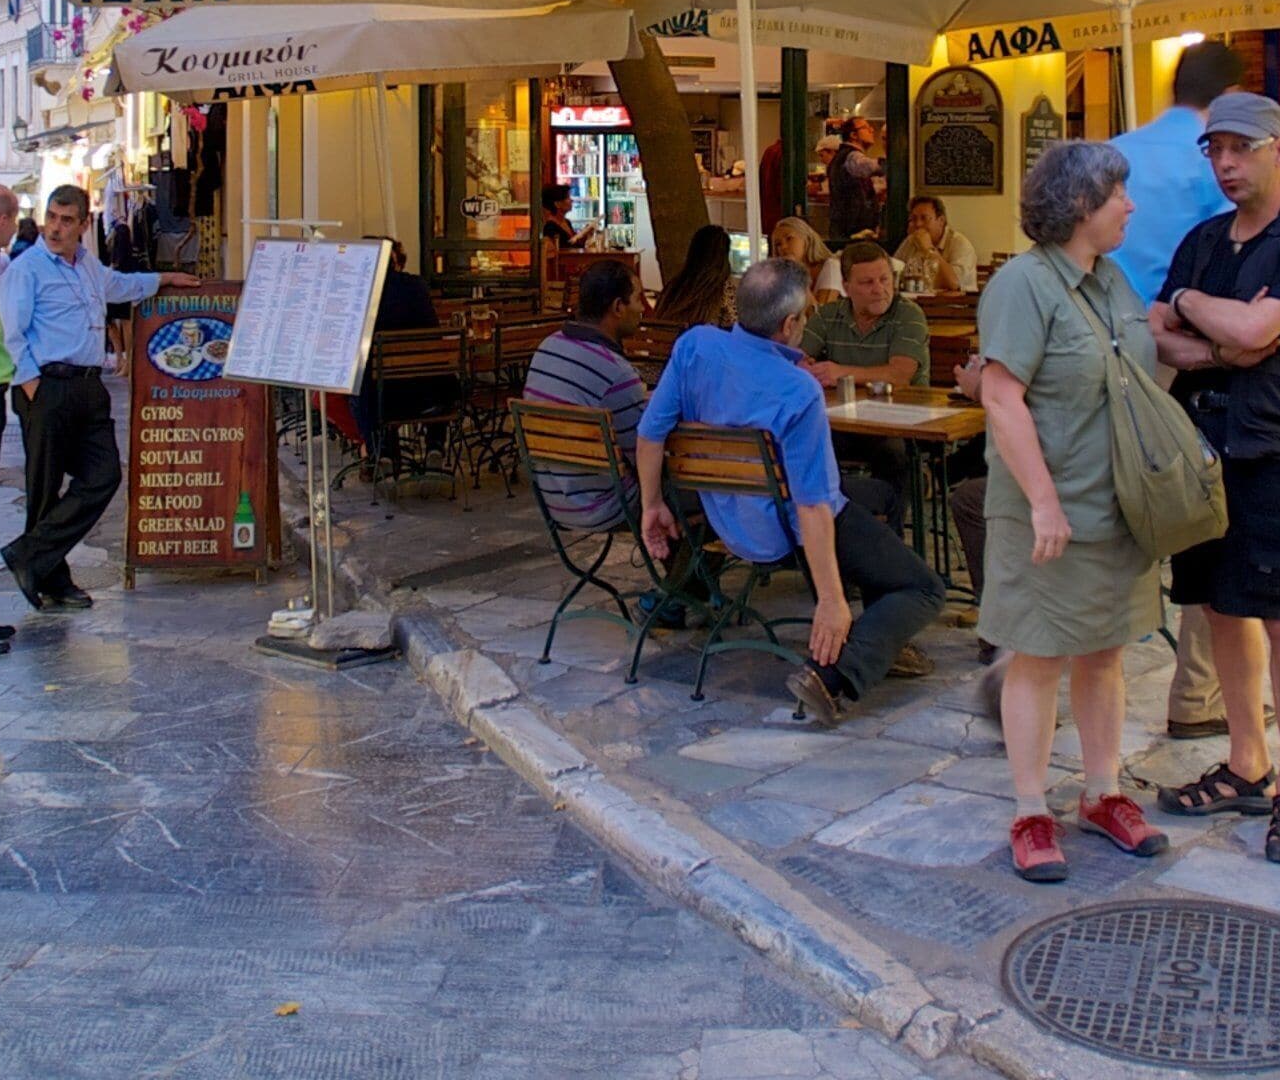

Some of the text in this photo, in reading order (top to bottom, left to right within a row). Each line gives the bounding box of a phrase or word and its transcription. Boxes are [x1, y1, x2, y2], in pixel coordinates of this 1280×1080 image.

[968, 22, 1061, 62] ΑΛΦΑ
[1072, 14, 1171, 39] ΠΑΡΑΔΣΙΑΚΑ
[227, 64, 319, 83] GRILL HOUSE
[141, 406, 184, 421] GYROS
[140, 427, 245, 443] CHICKEN GYROS
[140, 450, 203, 465] SOUVLAKI
[139, 472, 224, 487] MIXED GRILL
[138, 495, 202, 510] SEA FOOD
[138, 517, 225, 532] GREEK SALAD
[138, 540, 219, 555] DRAFT BEER
